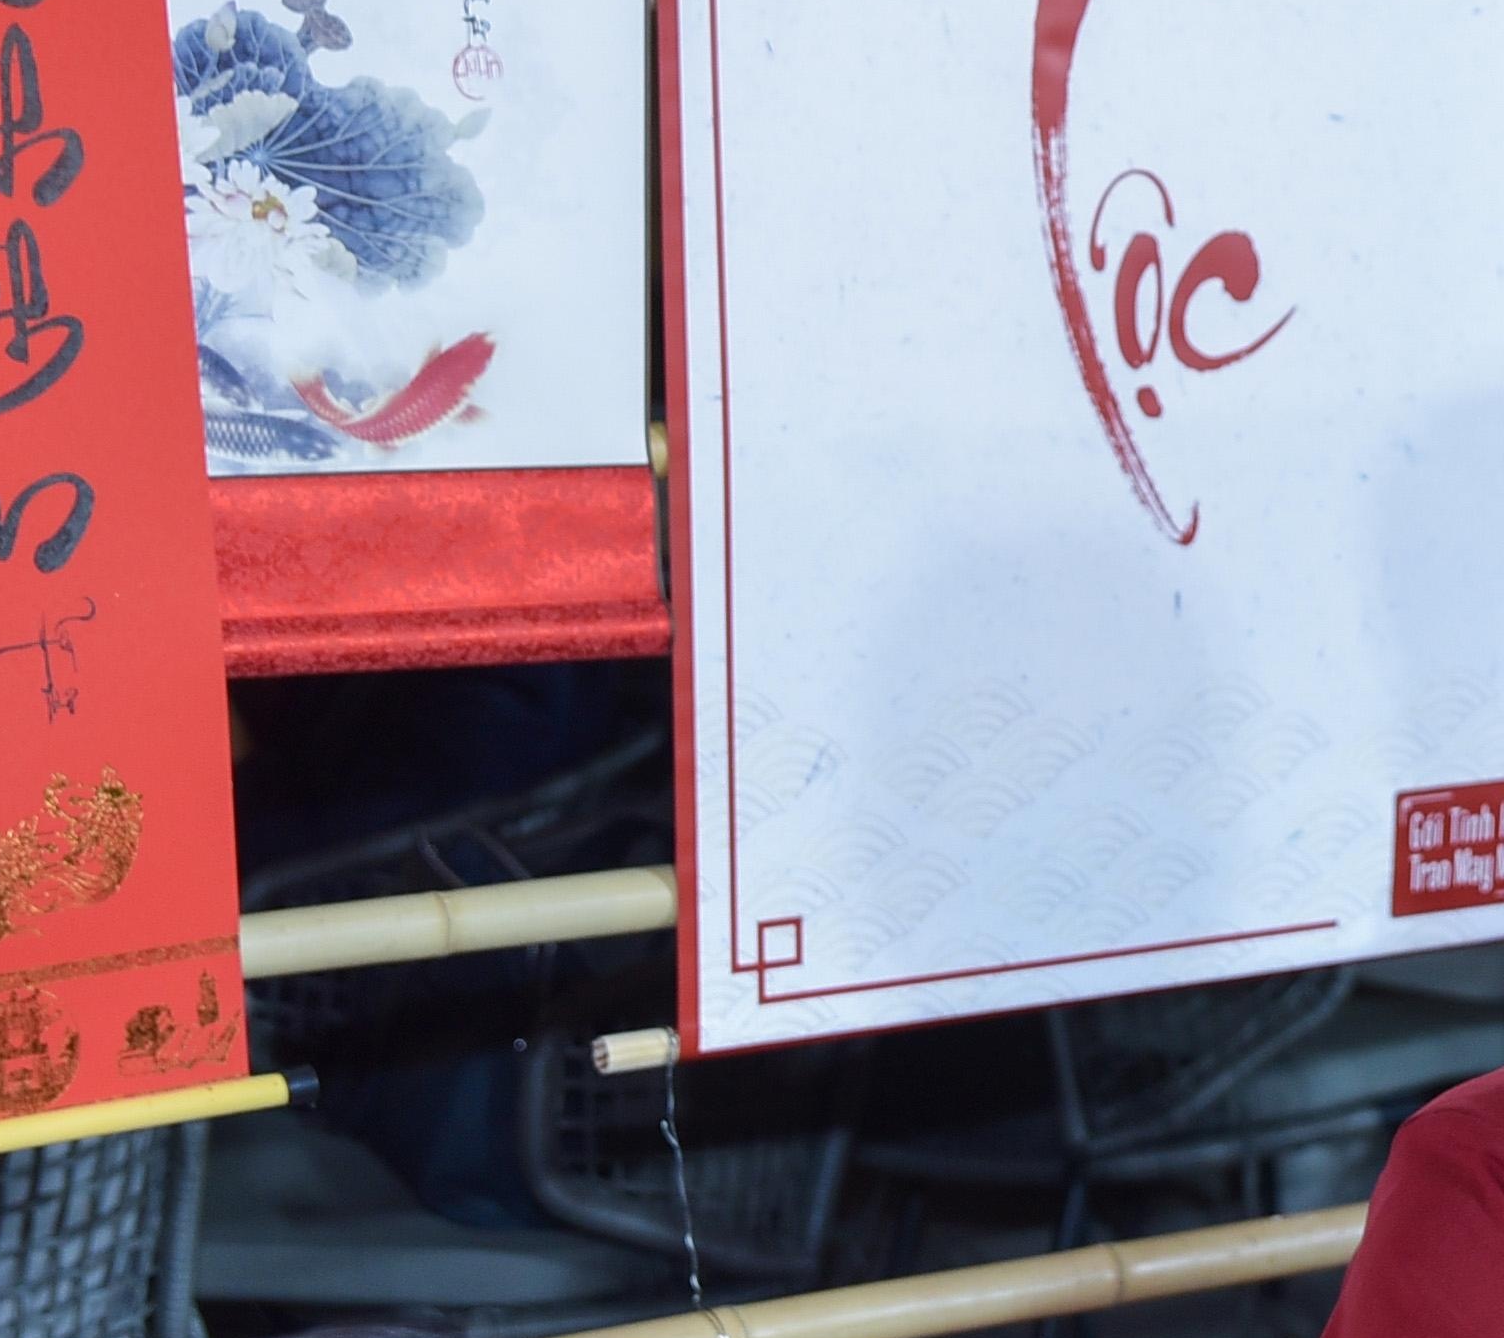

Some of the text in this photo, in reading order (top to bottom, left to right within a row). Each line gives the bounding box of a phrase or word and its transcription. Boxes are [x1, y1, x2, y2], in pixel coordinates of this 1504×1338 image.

[1408, 811, 1446, 852] Gói
[1409, 853, 1453, 894] Trao
[1453, 847, 1495, 894] May
